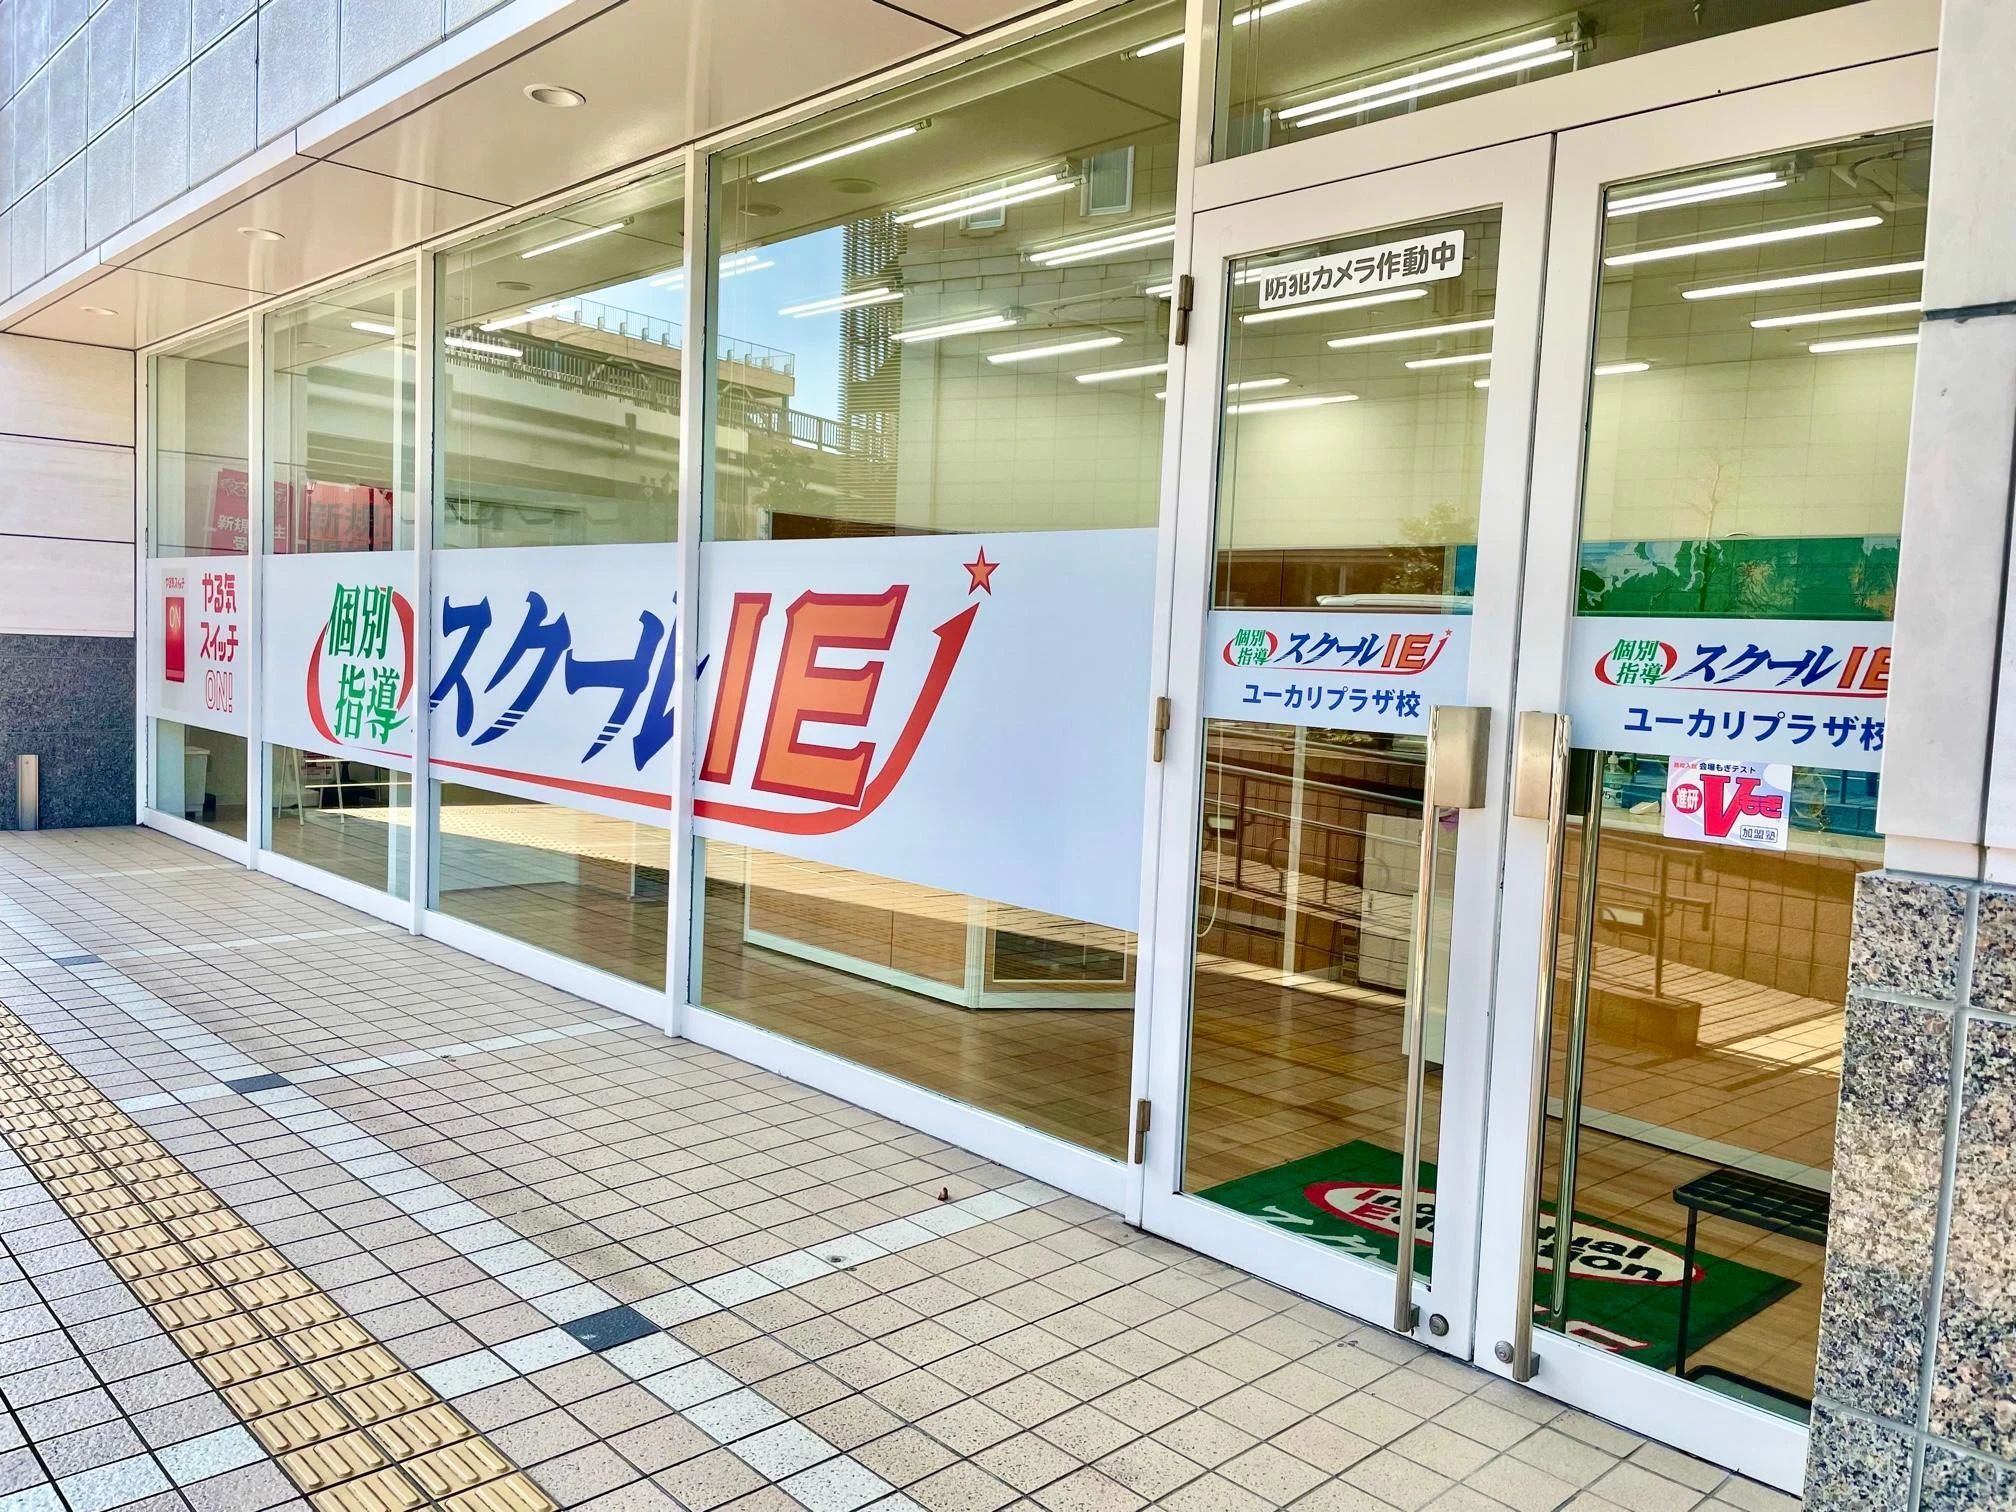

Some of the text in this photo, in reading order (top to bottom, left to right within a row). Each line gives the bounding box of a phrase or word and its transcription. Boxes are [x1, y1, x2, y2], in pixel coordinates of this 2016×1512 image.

[1265, 240, 1456, 301] 防犯カメラ作動中
[202, 573, 237, 613] やる気
[169, 606, 181, 628] ON
[328, 582, 394, 660] 個別
[200, 621, 239, 662] スイッチ
[1235, 628, 1266, 647] 個別
[1273, 632, 1434, 670] スクールIE
[1611, 638, 1660, 661] 個別
[1237, 647, 1269, 666] 指導
[1616, 662, 1666, 686] 指導
[205, 669, 233, 714] ON!
[334, 663, 410, 745] 指導
[1242, 684, 1421, 718] ユーカリプラザ校
[1624, 707, 1885, 752] ユーカリプラザ校
[1699, 762, 1756, 774] 会場もぎテスト
[1676, 787, 1699, 810] 進研
[1742, 827, 1776, 841] 加盟塾
